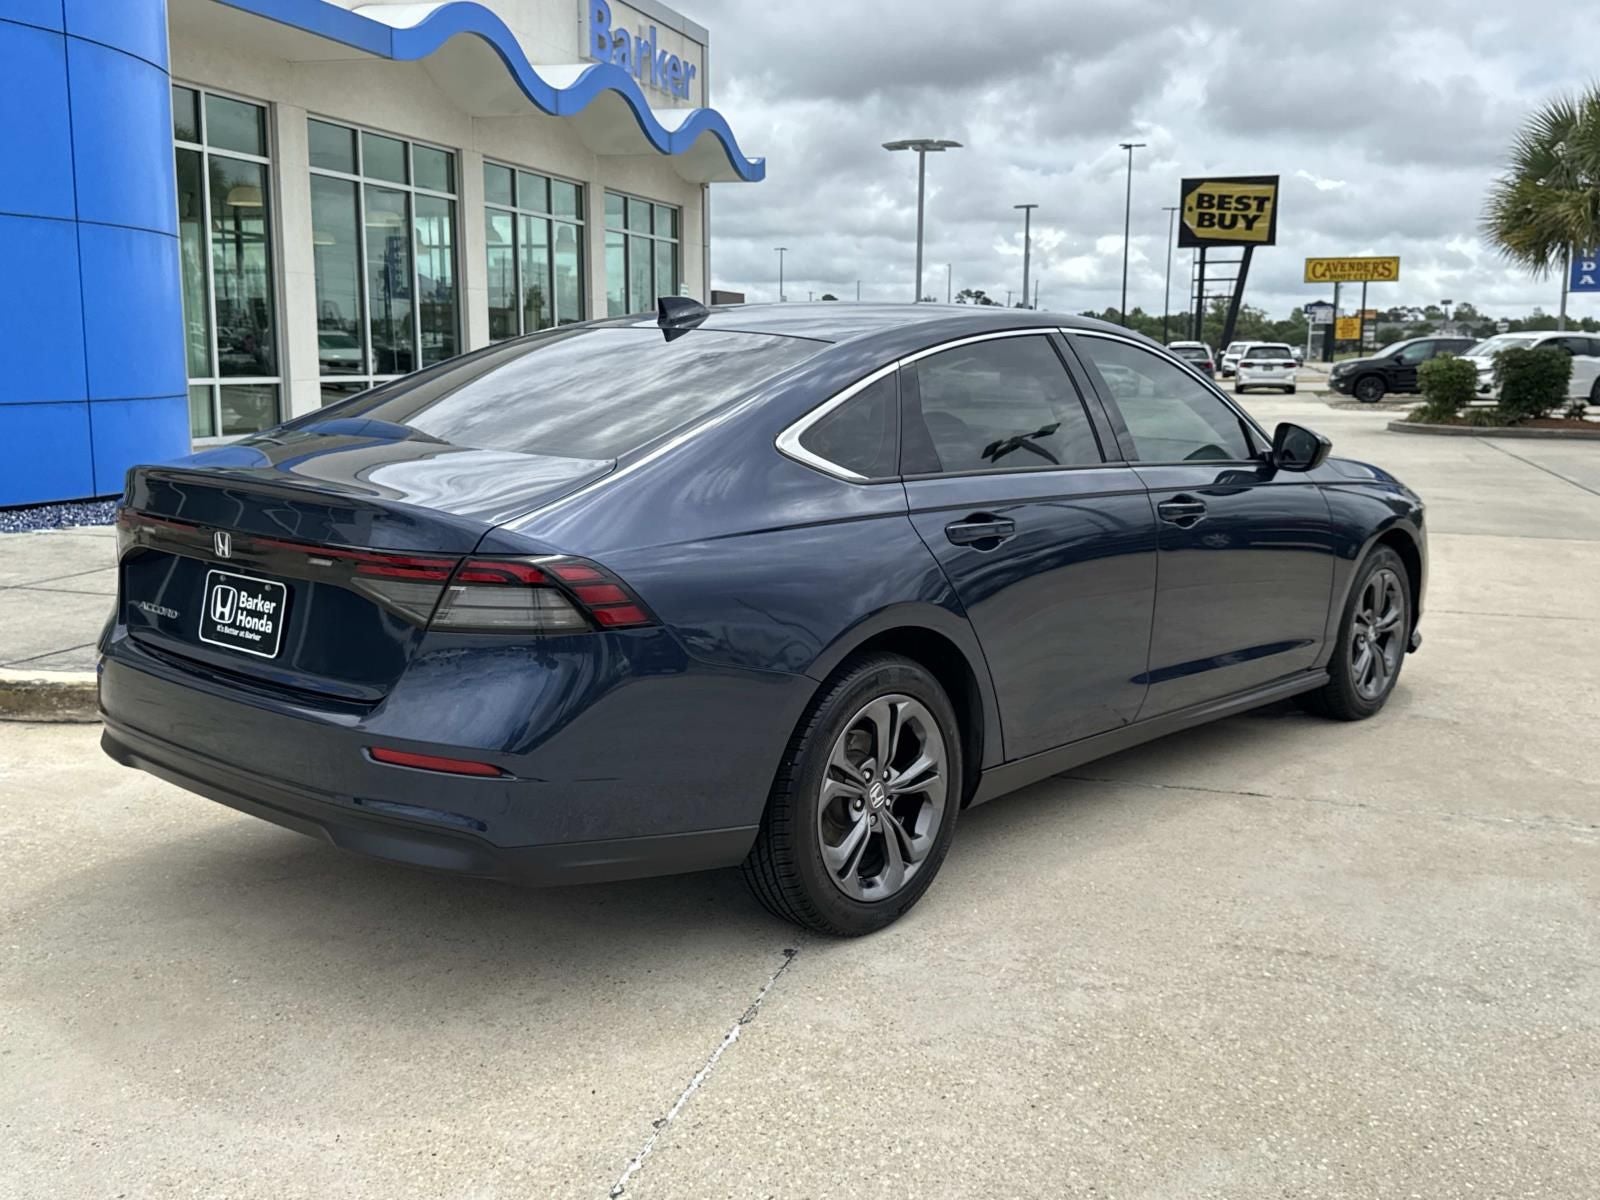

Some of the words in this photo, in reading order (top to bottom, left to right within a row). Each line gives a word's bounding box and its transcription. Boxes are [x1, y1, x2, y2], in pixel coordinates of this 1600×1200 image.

[590, 0, 696, 100] Barker
[1196, 193, 1271, 212] BEST
[1196, 211, 1262, 231] BUY
[137, 600, 178, 619] ACCORD
[239, 591, 277, 614] Barker
[236, 610, 273, 634] Honda
[245, 630, 262, 641] Barker
